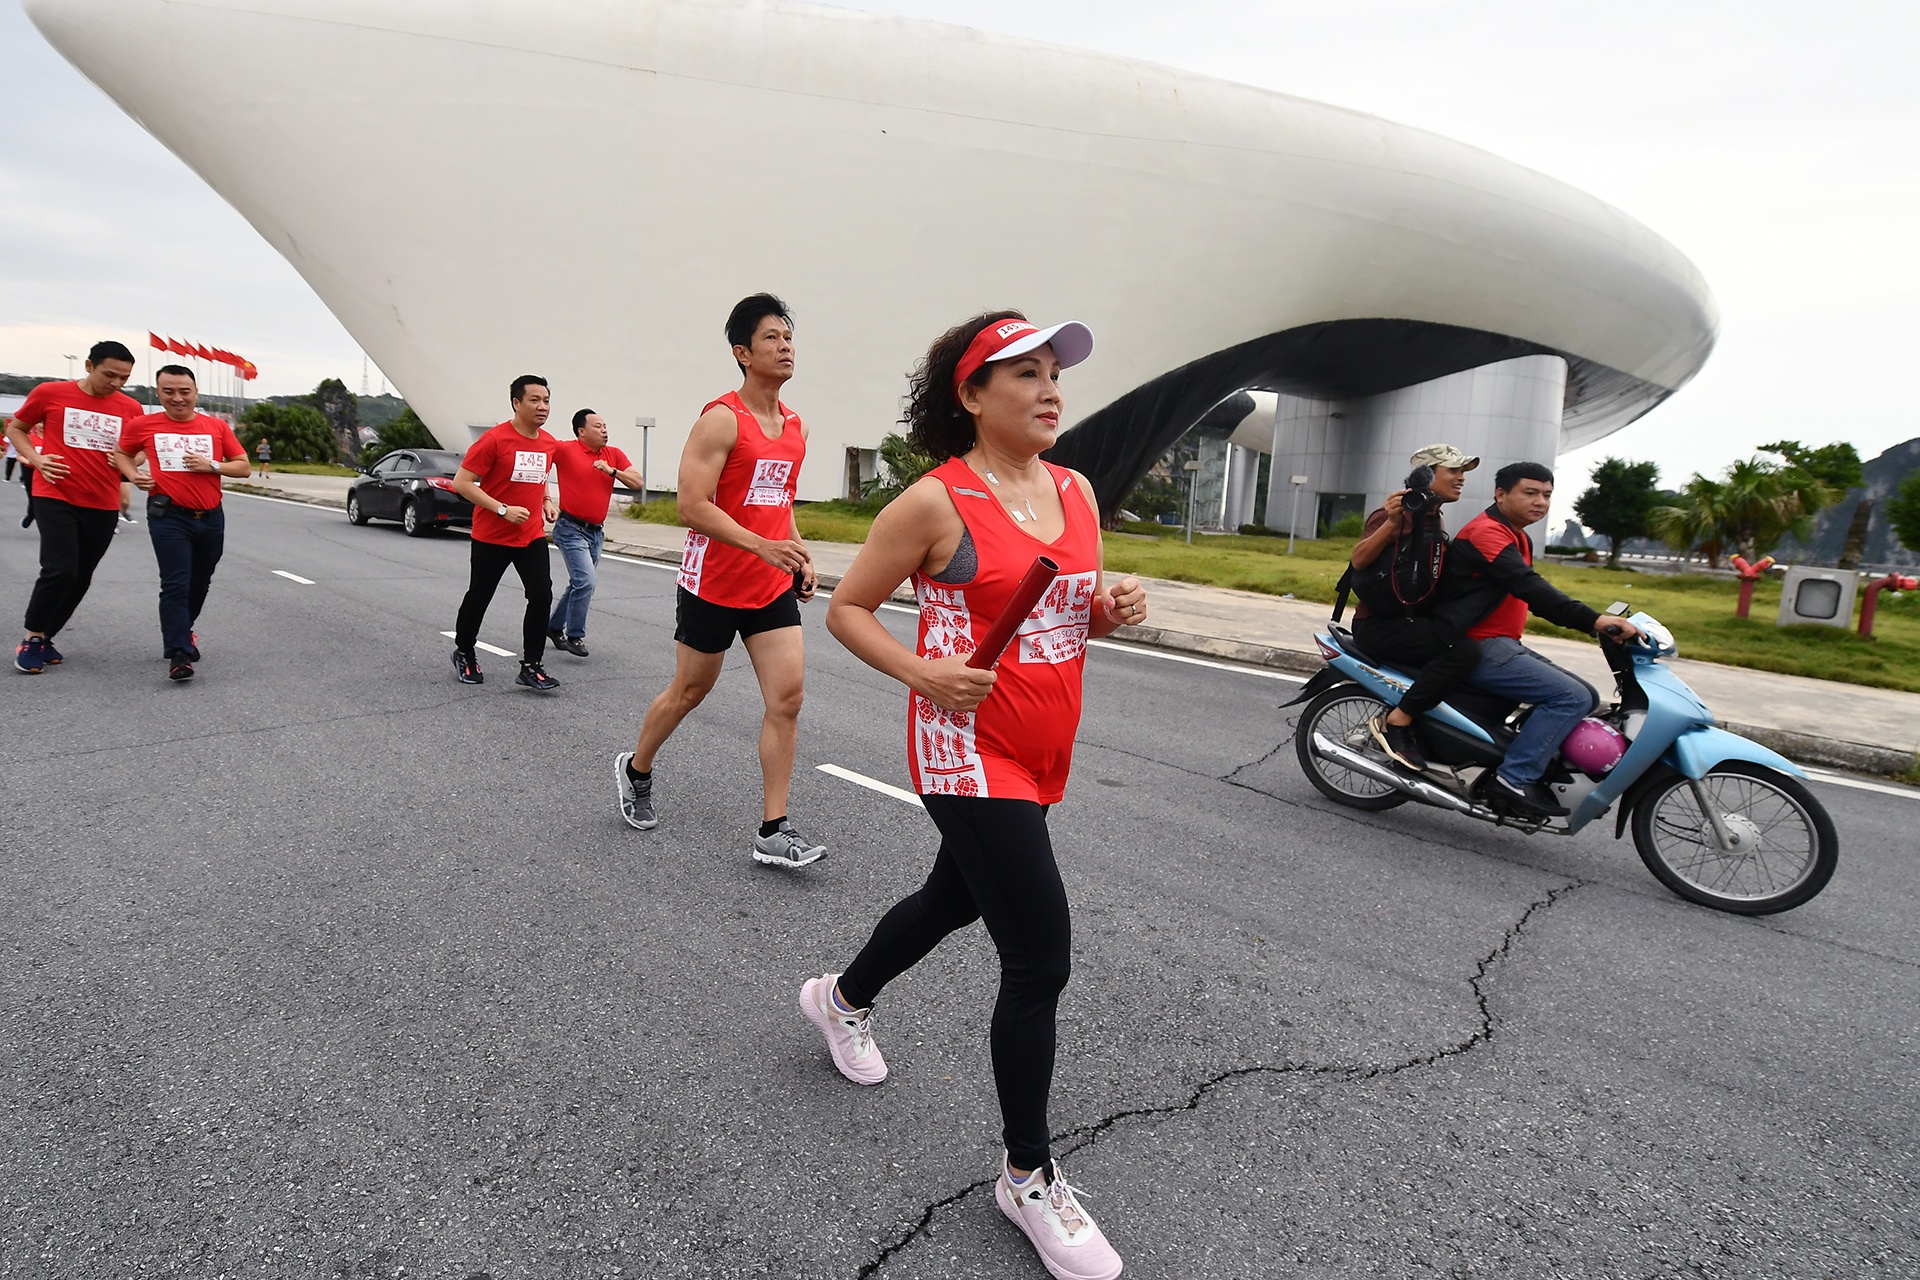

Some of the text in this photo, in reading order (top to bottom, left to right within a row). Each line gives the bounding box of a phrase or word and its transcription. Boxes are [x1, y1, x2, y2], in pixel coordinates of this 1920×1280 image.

[999, 323, 1019, 335] 145
[67, 411, 118, 435] 145
[157, 436, 209, 454] 145
[519, 453, 544, 467] 145
[757, 462, 788, 482] 145
[1028, 652, 1052, 662] SABO
